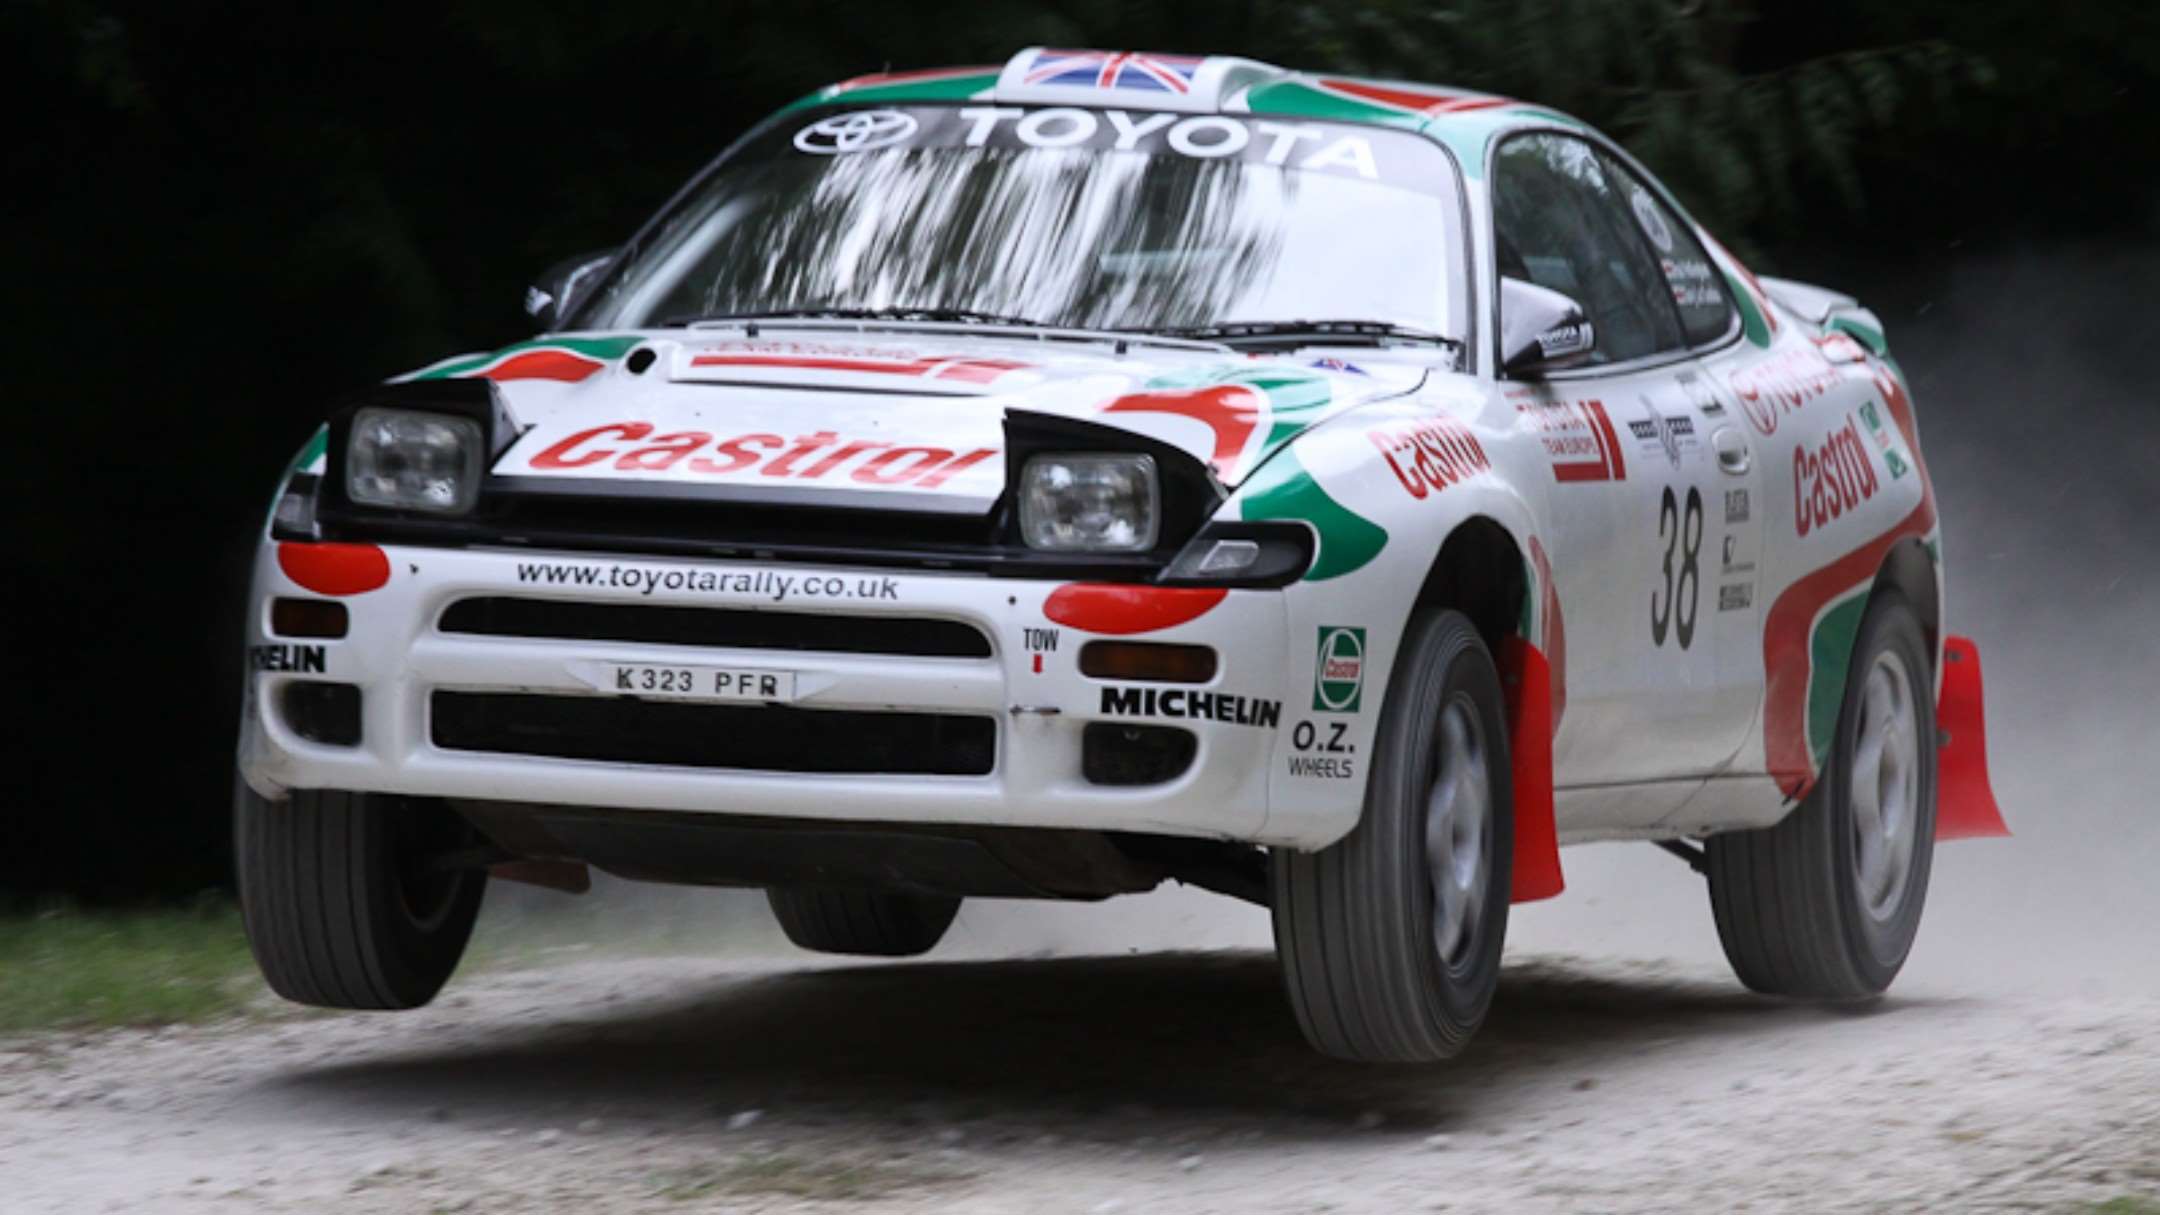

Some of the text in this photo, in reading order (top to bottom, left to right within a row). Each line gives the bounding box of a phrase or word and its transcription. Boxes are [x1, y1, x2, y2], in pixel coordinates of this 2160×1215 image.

[957, 107, 1379, 178] TOYOTA
[528, 421, 1000, 488] Castrol
[1369, 418, 1491, 500] Castrol
[1794, 413, 1879, 537] Castrol
[516, 561, 900, 601] www.toyotarally.co.uk
[1652, 485, 1704, 650] 38
[1023, 628, 1060, 651] TOW
[616, 666, 779, 696] K323 PFR
[1100, 686, 1282, 729] MICHELIN
[1292, 720, 1357, 754] O.Z.
[1288, 757, 1354, 779] WHEELS
